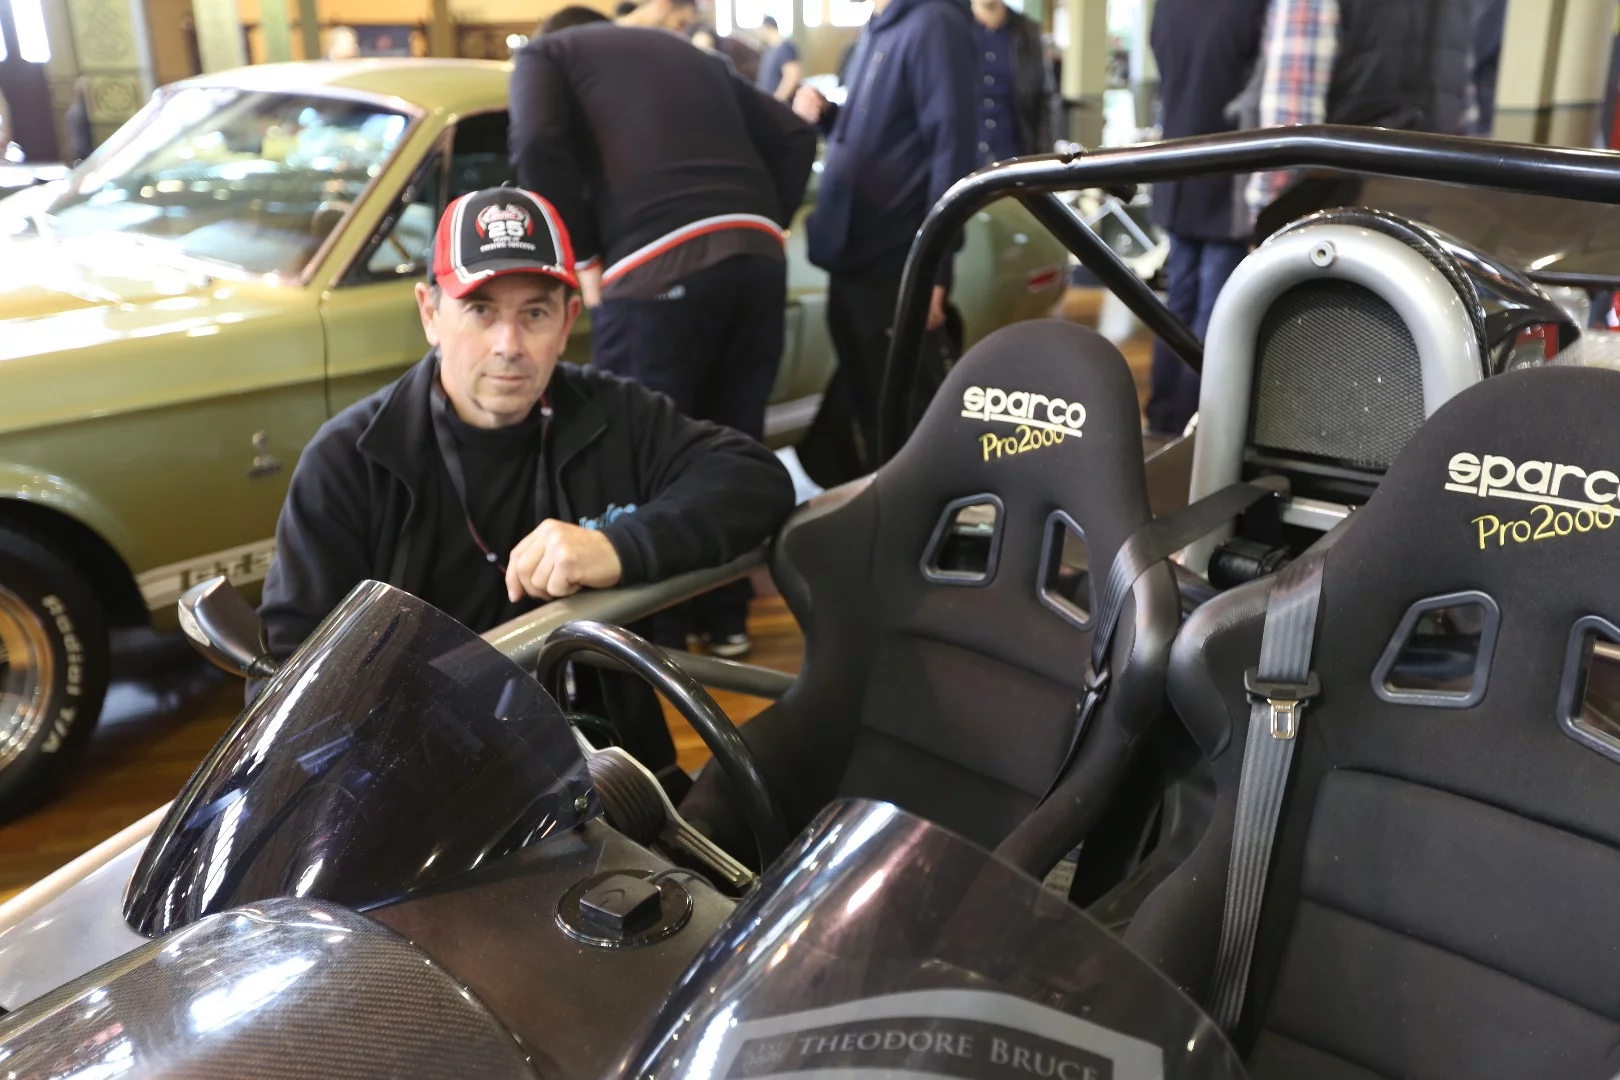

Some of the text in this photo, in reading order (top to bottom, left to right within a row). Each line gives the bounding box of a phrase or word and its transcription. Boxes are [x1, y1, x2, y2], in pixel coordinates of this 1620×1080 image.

[487, 220, 525, 239] 25
[962, 385, 1087, 430] sparco
[978, 423, 1066, 462] Pro2000
[1447, 451, 1620, 504] sparc
[1471, 504, 1616, 550] Pro2000
[799, 1029, 975, 1058] THEODORE
